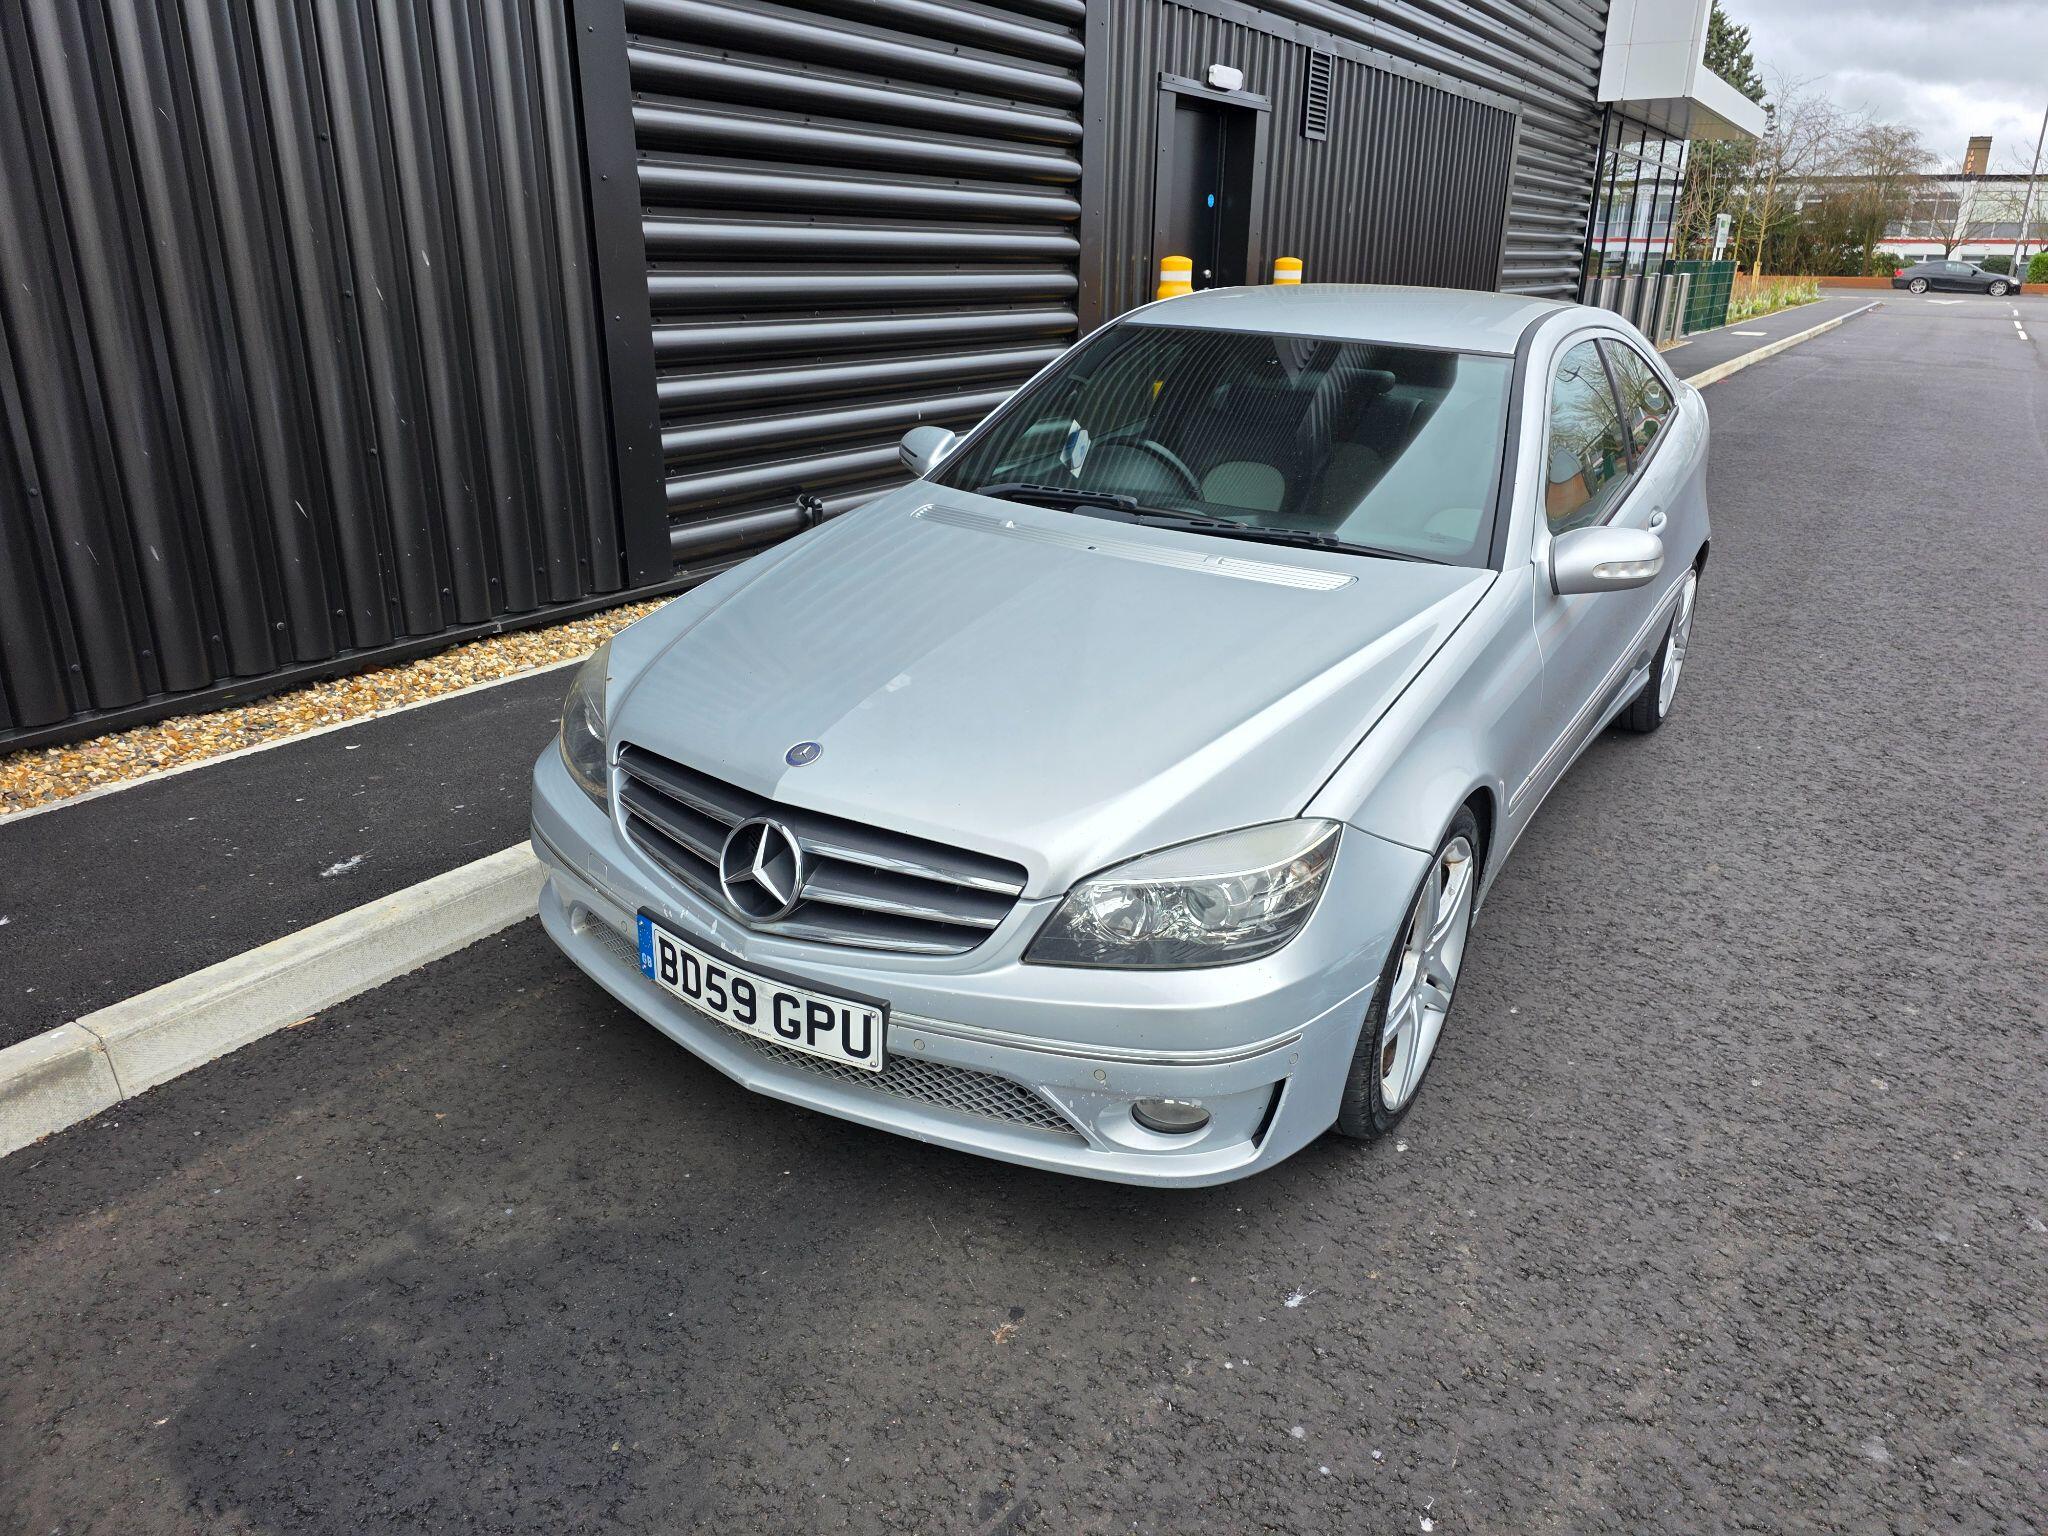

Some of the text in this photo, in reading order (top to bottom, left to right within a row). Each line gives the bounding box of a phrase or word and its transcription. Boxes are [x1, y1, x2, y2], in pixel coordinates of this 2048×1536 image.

[641, 952, 653, 968] GB
[659, 936, 872, 1059] BD59 GPU
